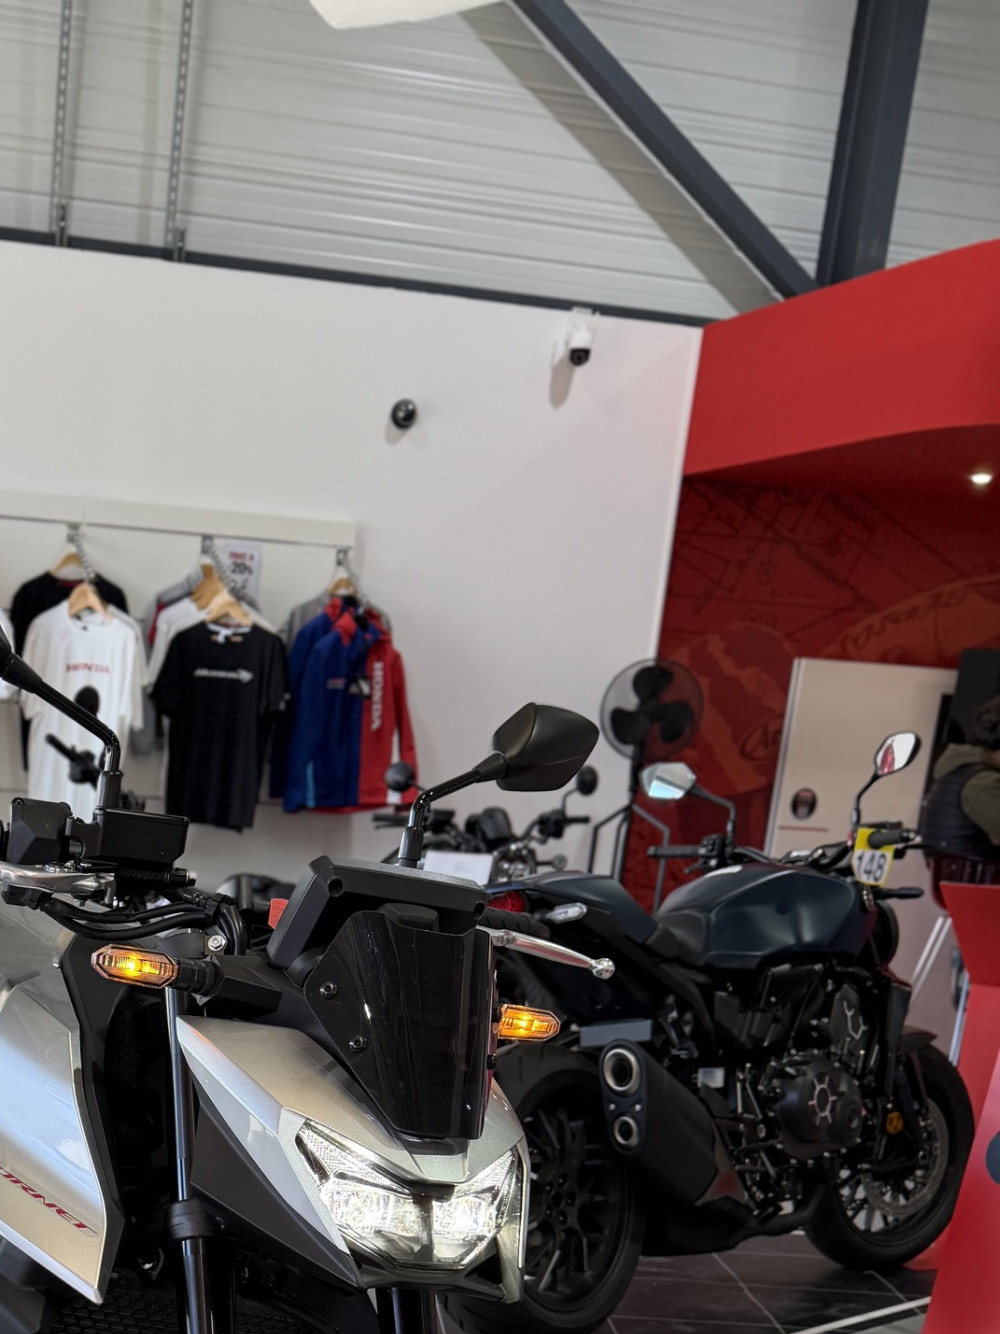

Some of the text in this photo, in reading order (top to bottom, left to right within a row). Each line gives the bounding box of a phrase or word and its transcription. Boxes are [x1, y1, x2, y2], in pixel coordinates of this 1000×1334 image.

[65, 661, 111, 673] HONDA
[371, 661, 384, 732] HONDA
[857, 850, 887, 882] 148
